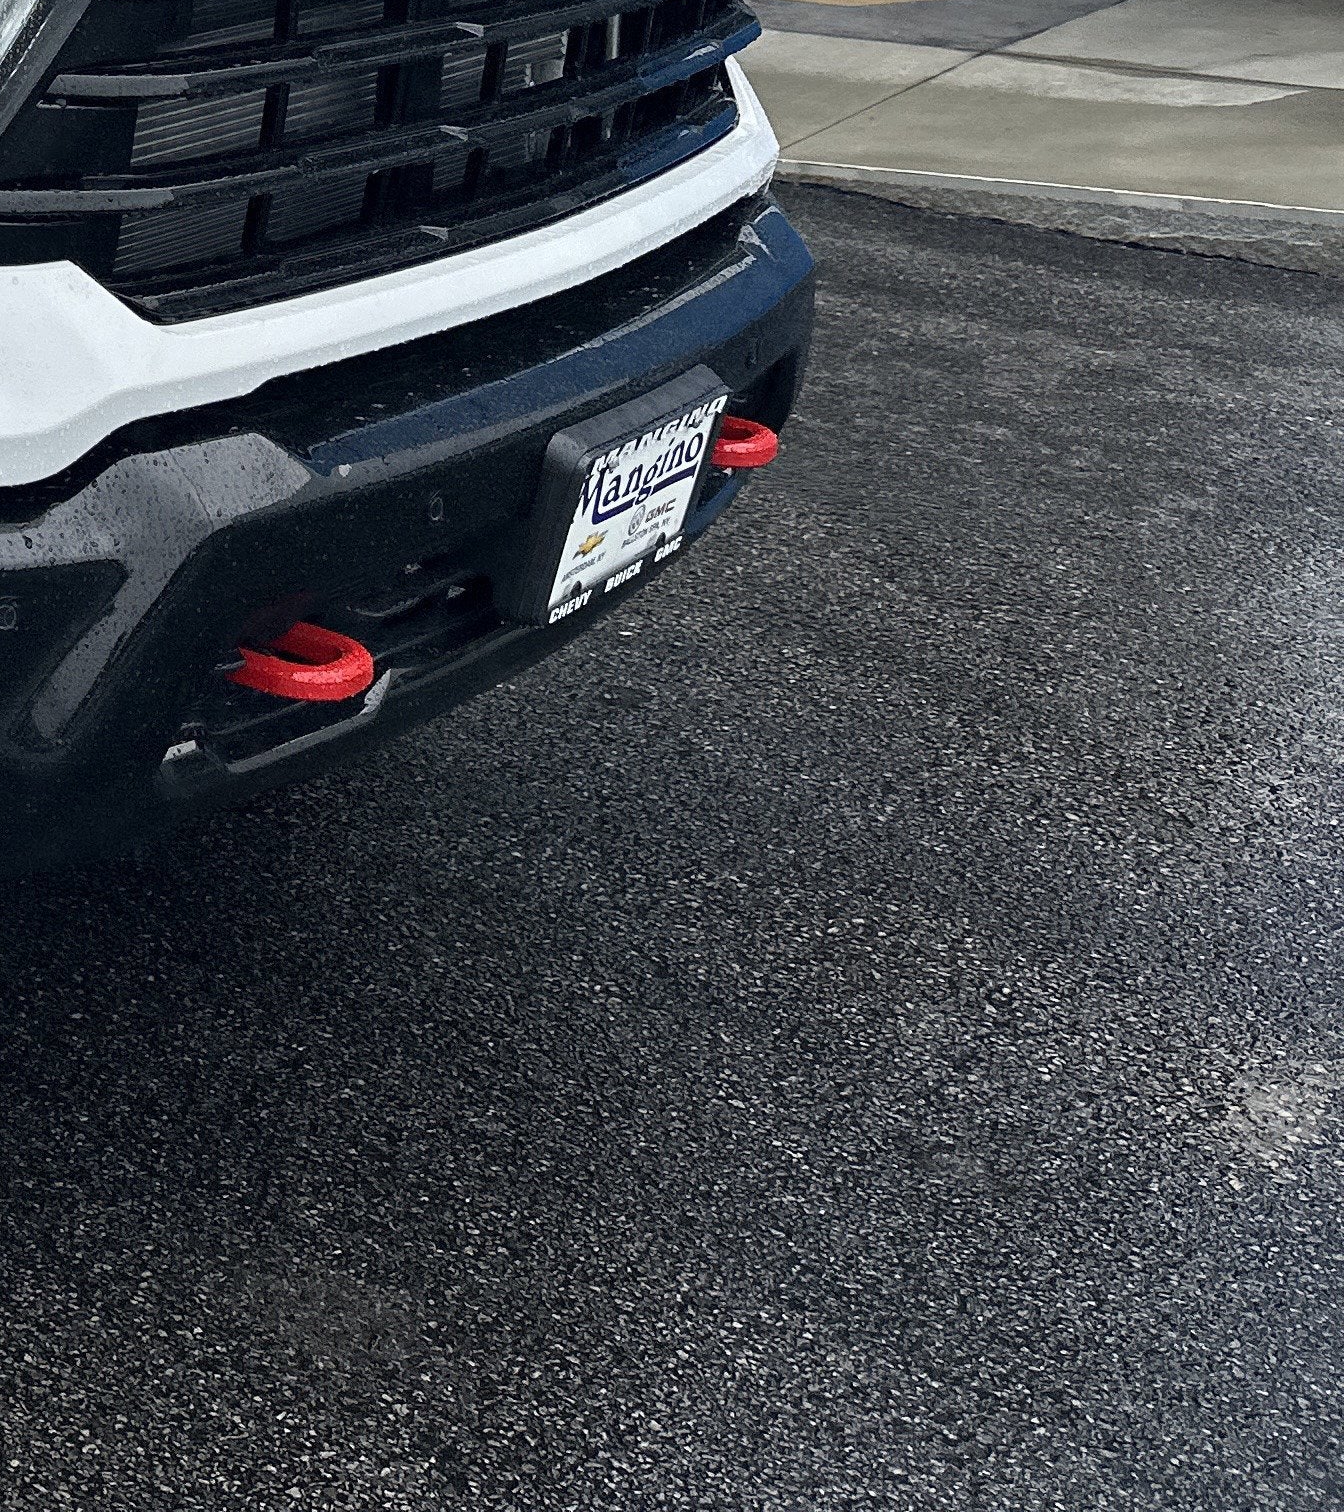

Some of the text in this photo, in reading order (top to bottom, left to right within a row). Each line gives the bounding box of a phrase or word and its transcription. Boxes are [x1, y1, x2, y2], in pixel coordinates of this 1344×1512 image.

[591, 394, 728, 476] MANGINO
[579, 432, 704, 525] Mangino
[645, 498, 677, 523] GMC
[548, 535, 683, 624] CHEVY BUICK GMC
